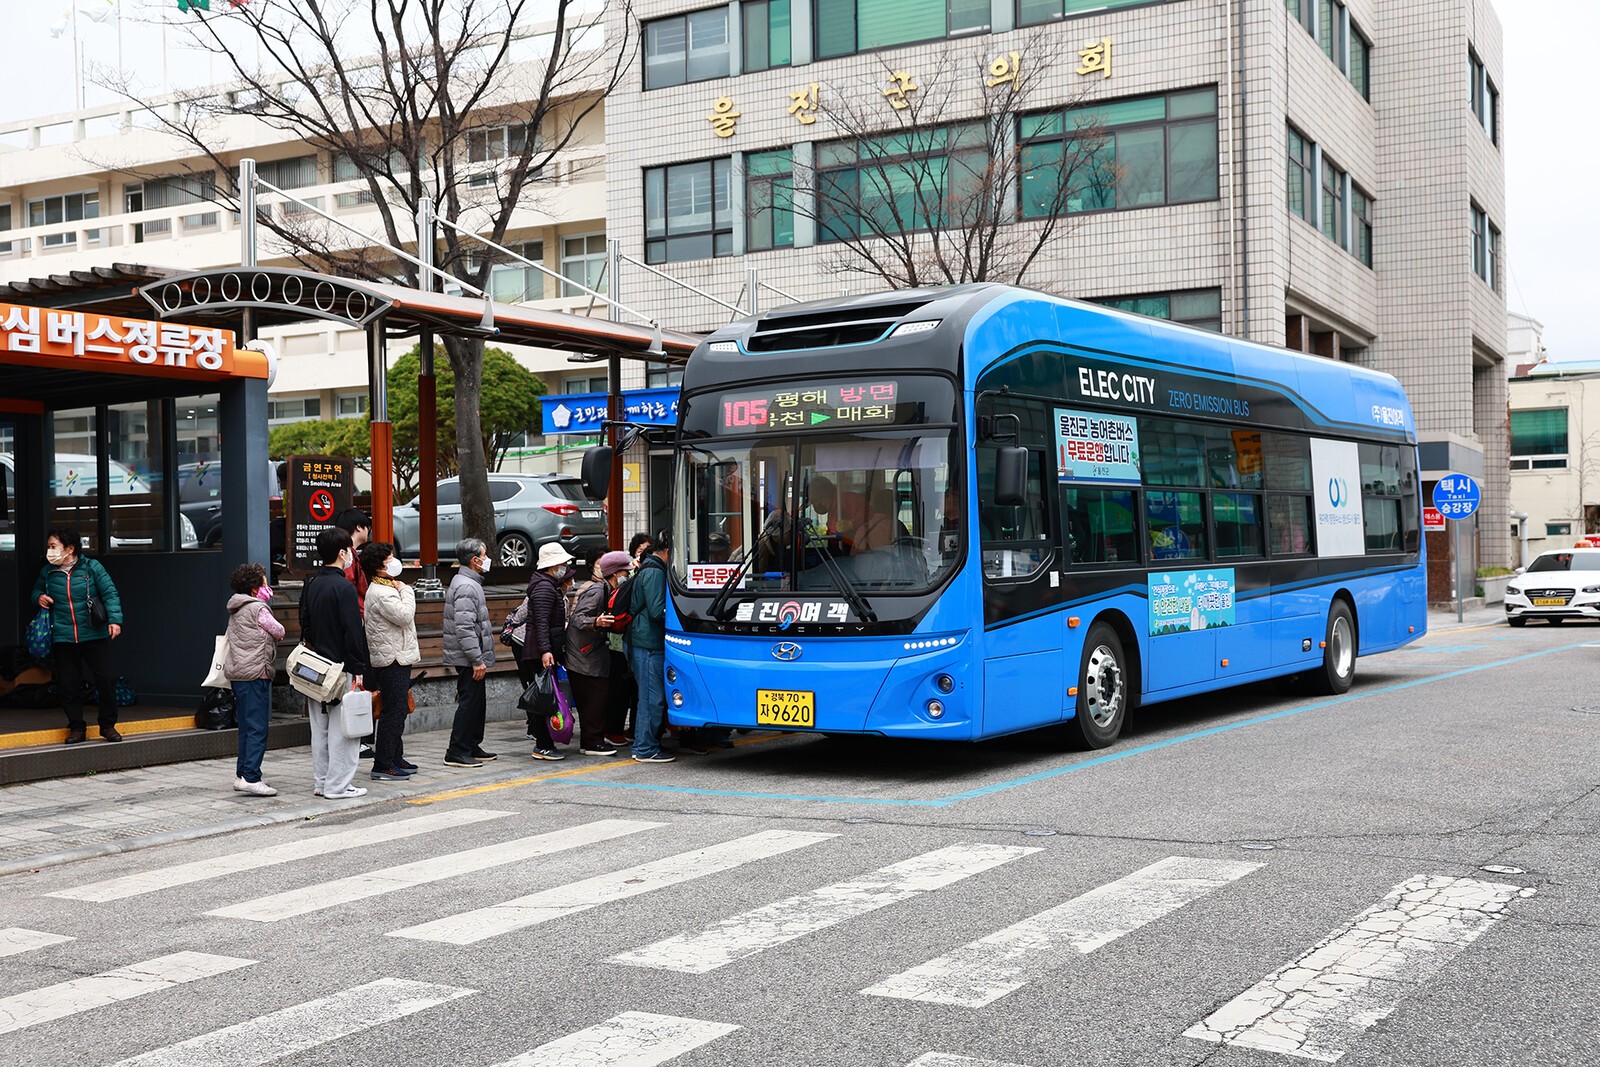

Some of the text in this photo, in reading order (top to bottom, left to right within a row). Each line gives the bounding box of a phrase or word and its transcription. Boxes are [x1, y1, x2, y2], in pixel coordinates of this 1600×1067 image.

[0, 307, 228, 371] 심 버스정류장
[775, 384, 894, 408] 평해 방면
[1078, 367, 1250, 417] ELEC CITY ZERO EMISSION BUS
[624, 401, 667, 420] 께하는
[724, 399, 768, 427] 105
[837, 404, 894, 421] 매화
[1060, 415, 1133, 441] 울진군 농어촌버스
[1067, 440, 1130, 463] 무료운행합니다
[303, 462, 342, 474] 금연구역
[1441, 478, 1470, 493] 택시
[1441, 502, 1472, 514] 승강장
[736, 602, 849, 622] 울진 여객
[771, 693, 799, 702] 경북 70
[760, 704, 810, 723] 자 9620
